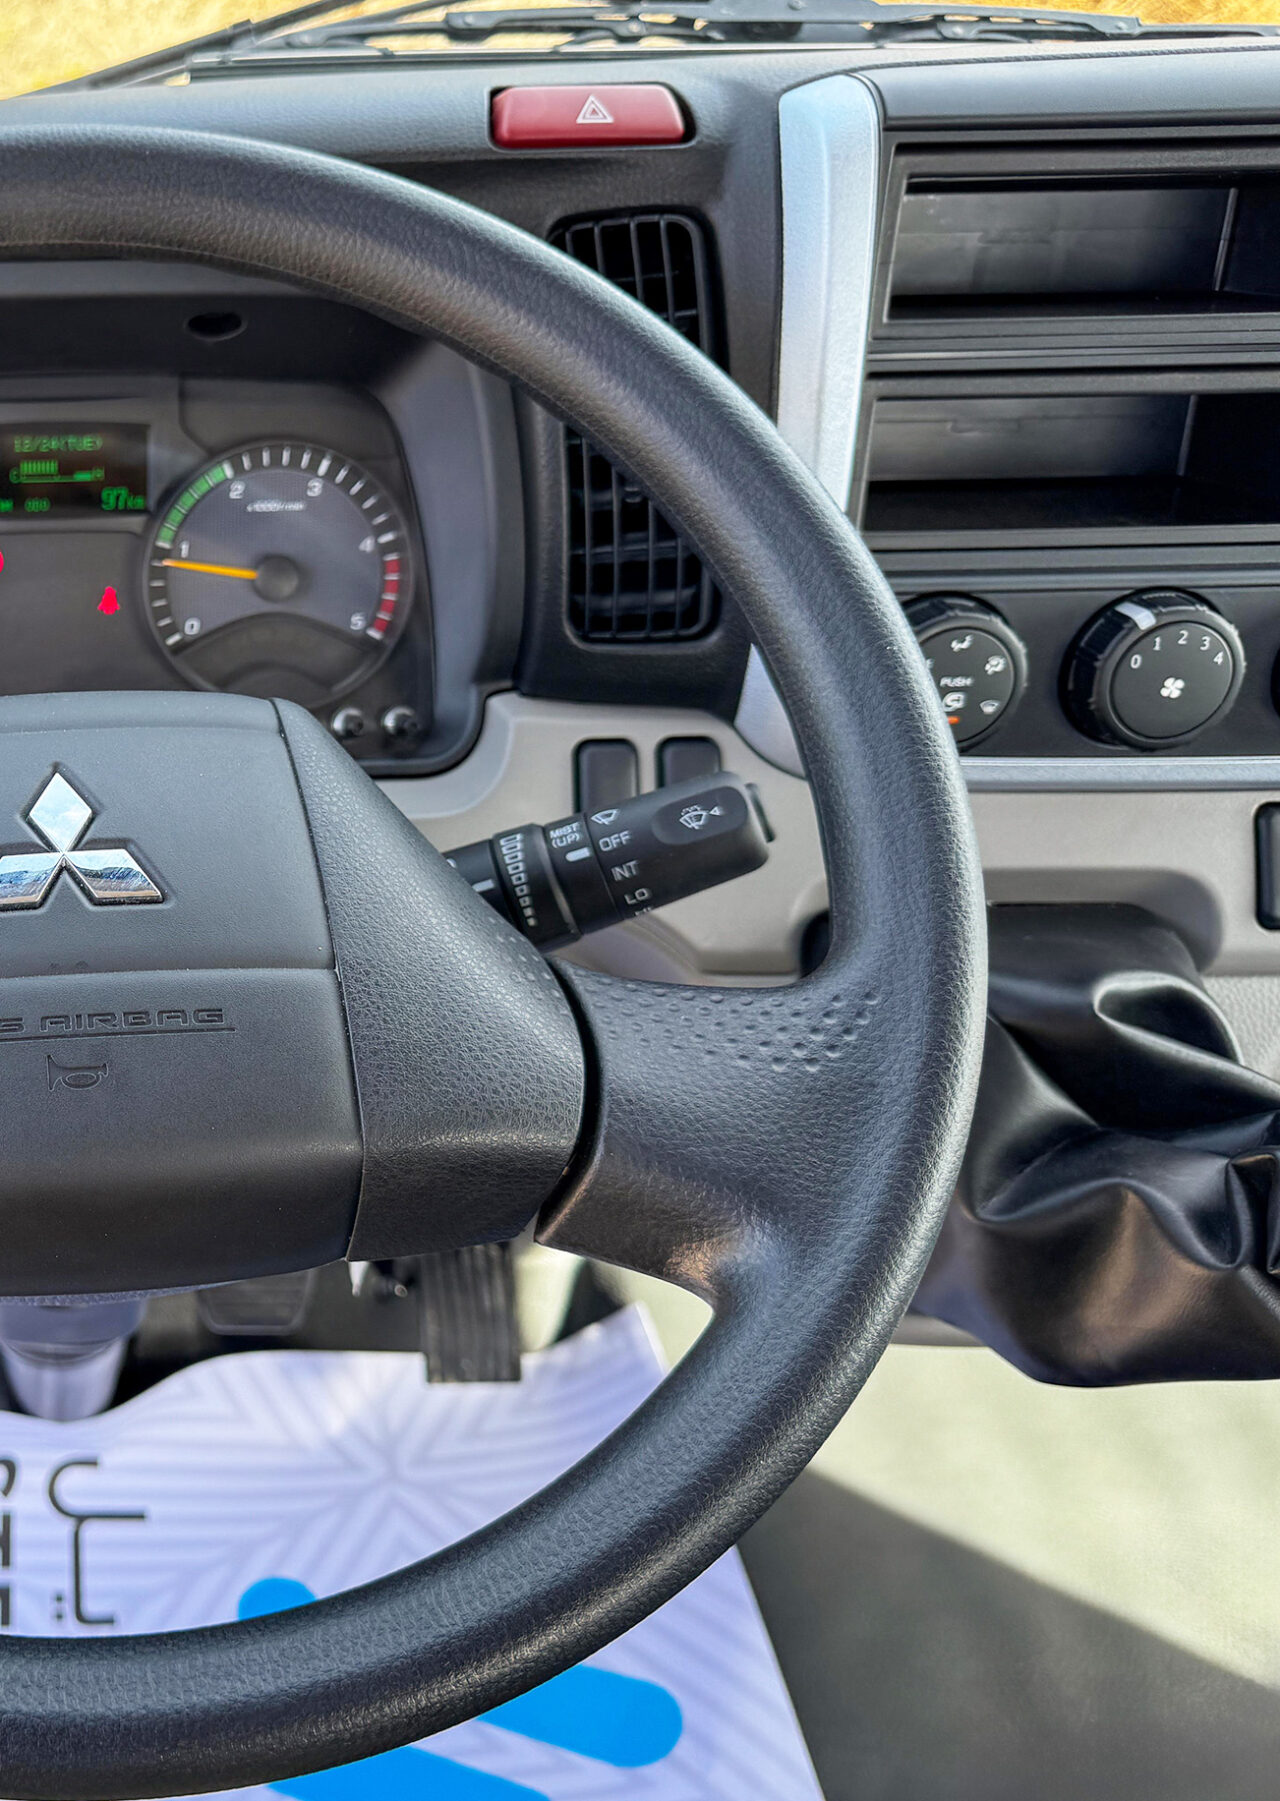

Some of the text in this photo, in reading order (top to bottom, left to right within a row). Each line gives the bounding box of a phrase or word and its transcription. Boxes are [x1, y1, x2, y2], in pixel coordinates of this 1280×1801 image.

[229, 481, 246, 499] 2
[307, 478, 323, 497] 3
[180, 540, 190, 558] 1
[358, 535, 376, 553] 4
[184, 618, 201, 636] 0
[350, 614, 366, 631] 5
[1130, 630, 1223, 670] 0 1 2 3 4
[940, 677, 973, 688] PUSH
[549, 821, 579, 838] MIST
[552, 832, 580, 848] (UP)
[599, 830, 632, 851] OFF
[612, 860, 640, 881] INT
[624, 887, 649, 905] LO
[39, 1007, 225, 1033] AIRBAG
